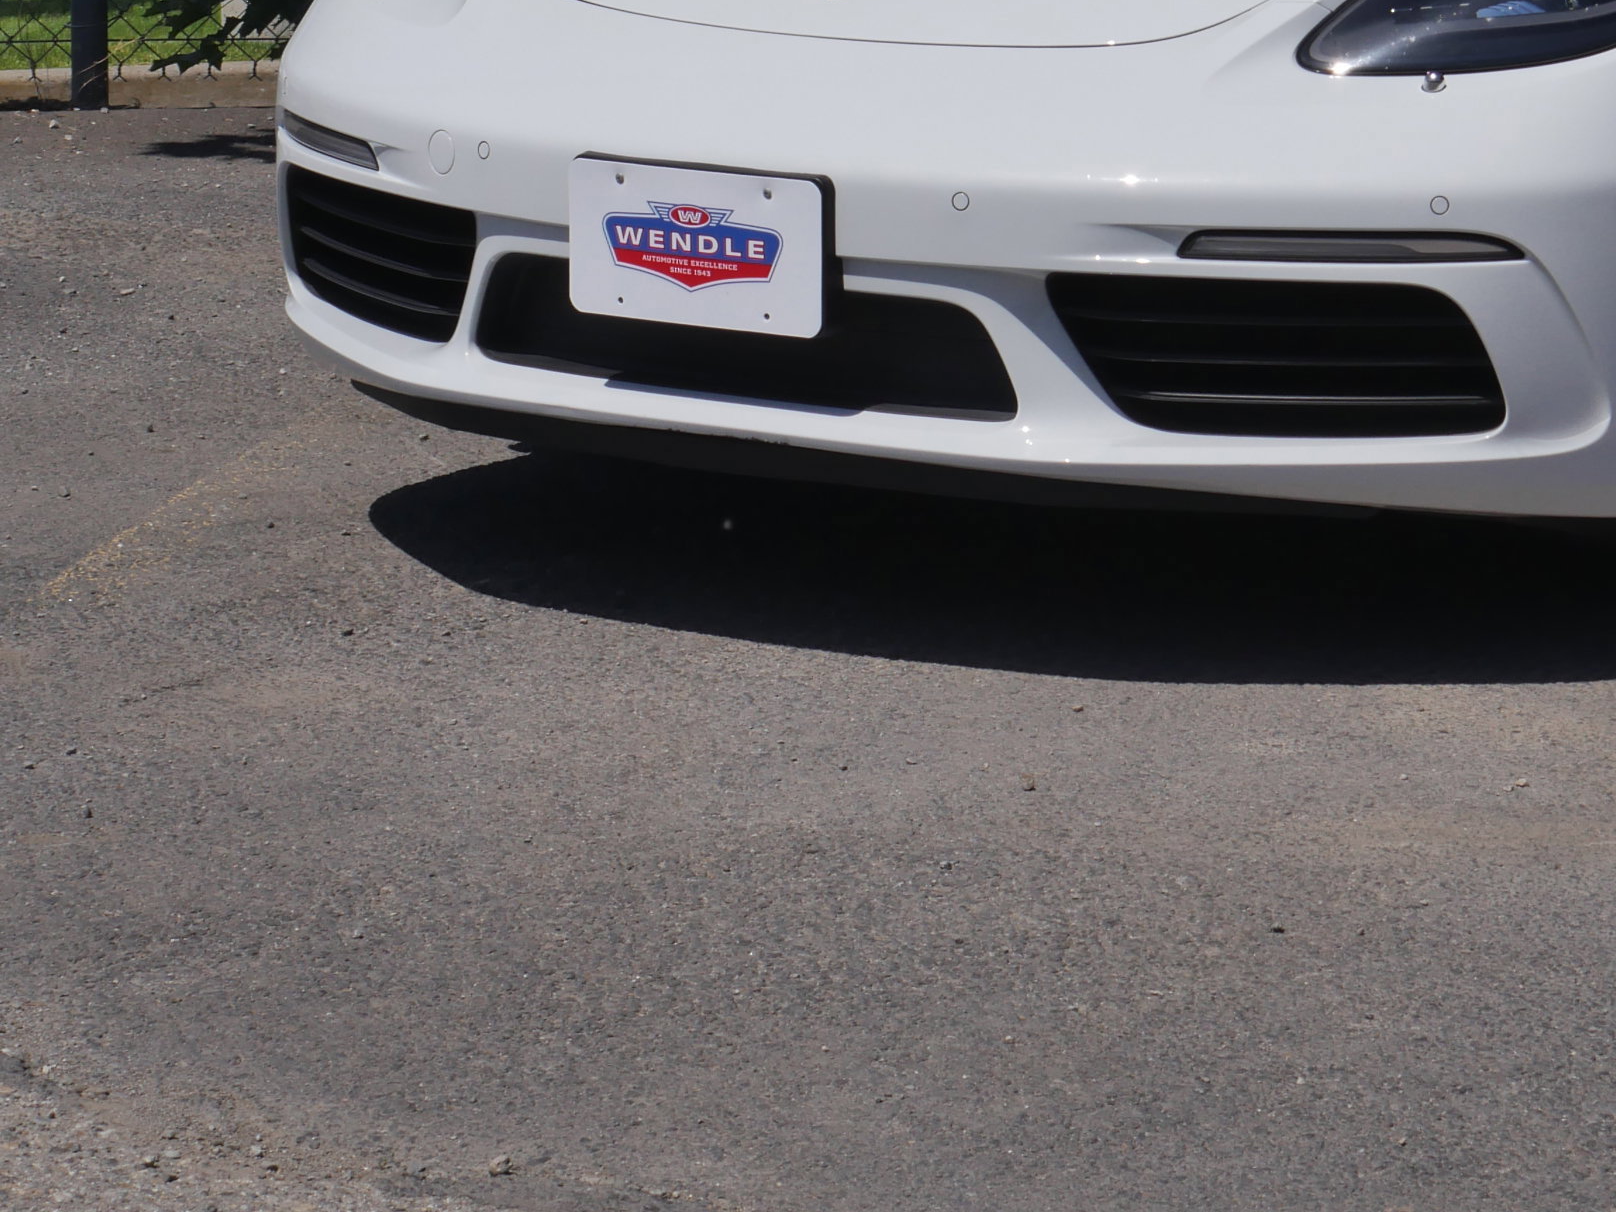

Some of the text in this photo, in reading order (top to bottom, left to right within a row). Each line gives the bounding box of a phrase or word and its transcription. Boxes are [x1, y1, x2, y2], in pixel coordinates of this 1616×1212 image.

[615, 225, 765, 259] WENDLE
[642, 254, 738, 271] AUTOMOTIVE EXCELLENCE
[669, 266, 692, 275] SINCE
